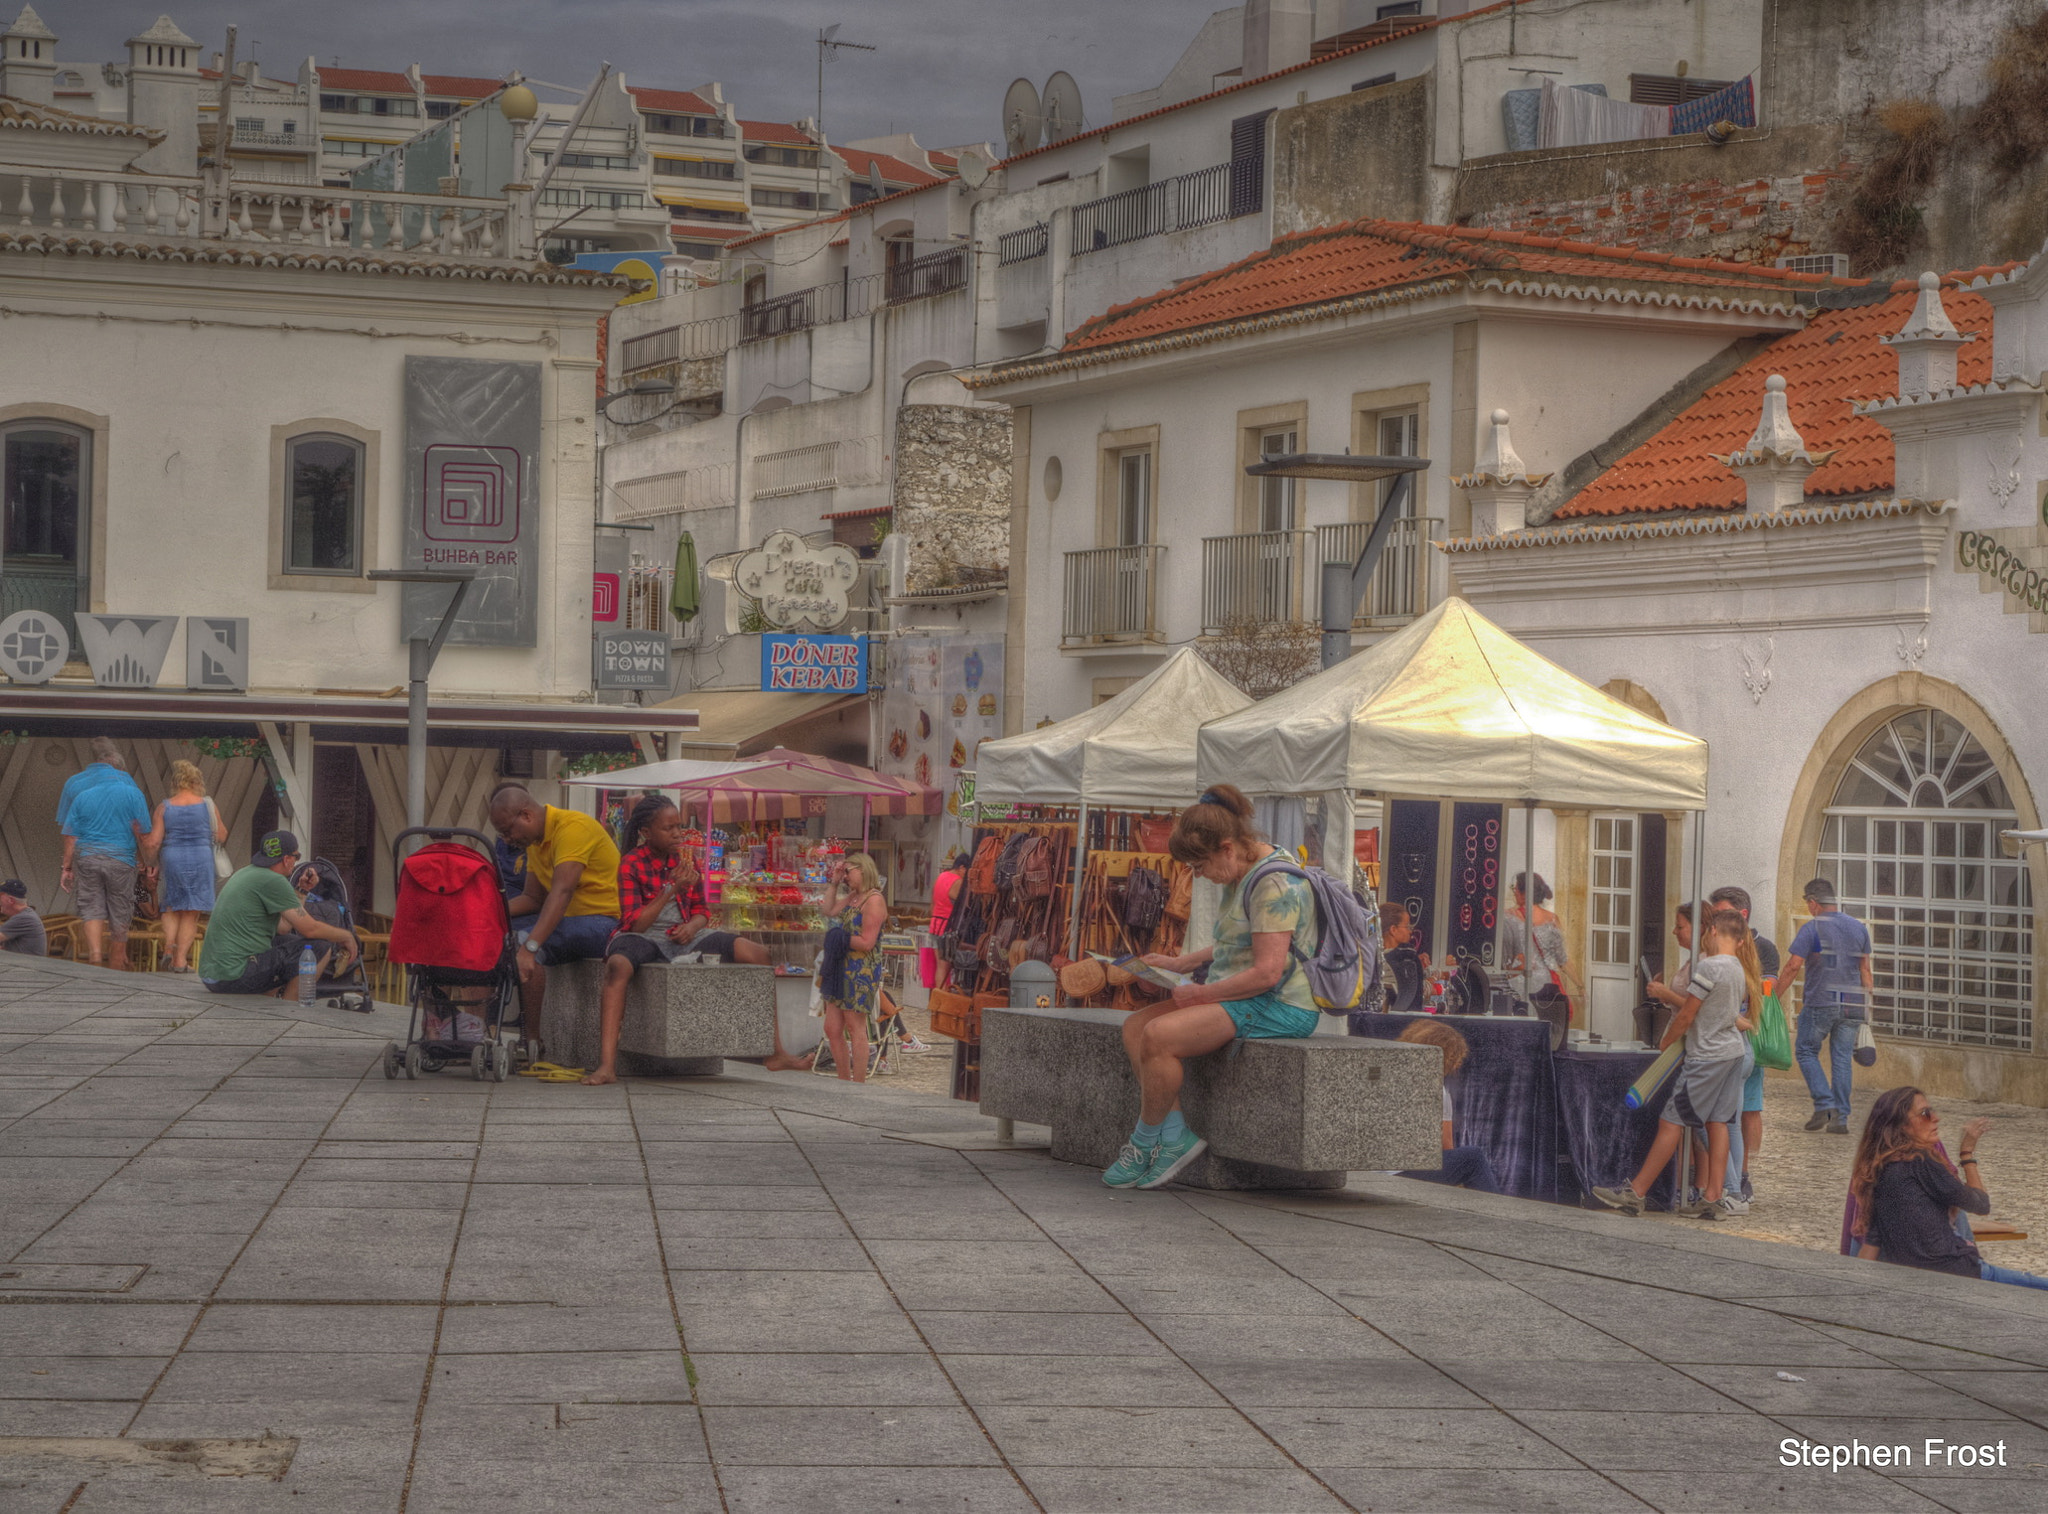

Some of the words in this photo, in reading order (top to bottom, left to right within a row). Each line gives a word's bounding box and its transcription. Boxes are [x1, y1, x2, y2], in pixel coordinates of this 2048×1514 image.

[423, 548, 479, 563] BUHBA
[485, 550, 518, 566] BAR
[605, 640, 665, 656] DOWN
[770, 638, 859, 666] DÖNER
[604, 656, 665, 672] TOWN
[770, 666, 859, 690] KEBAB
